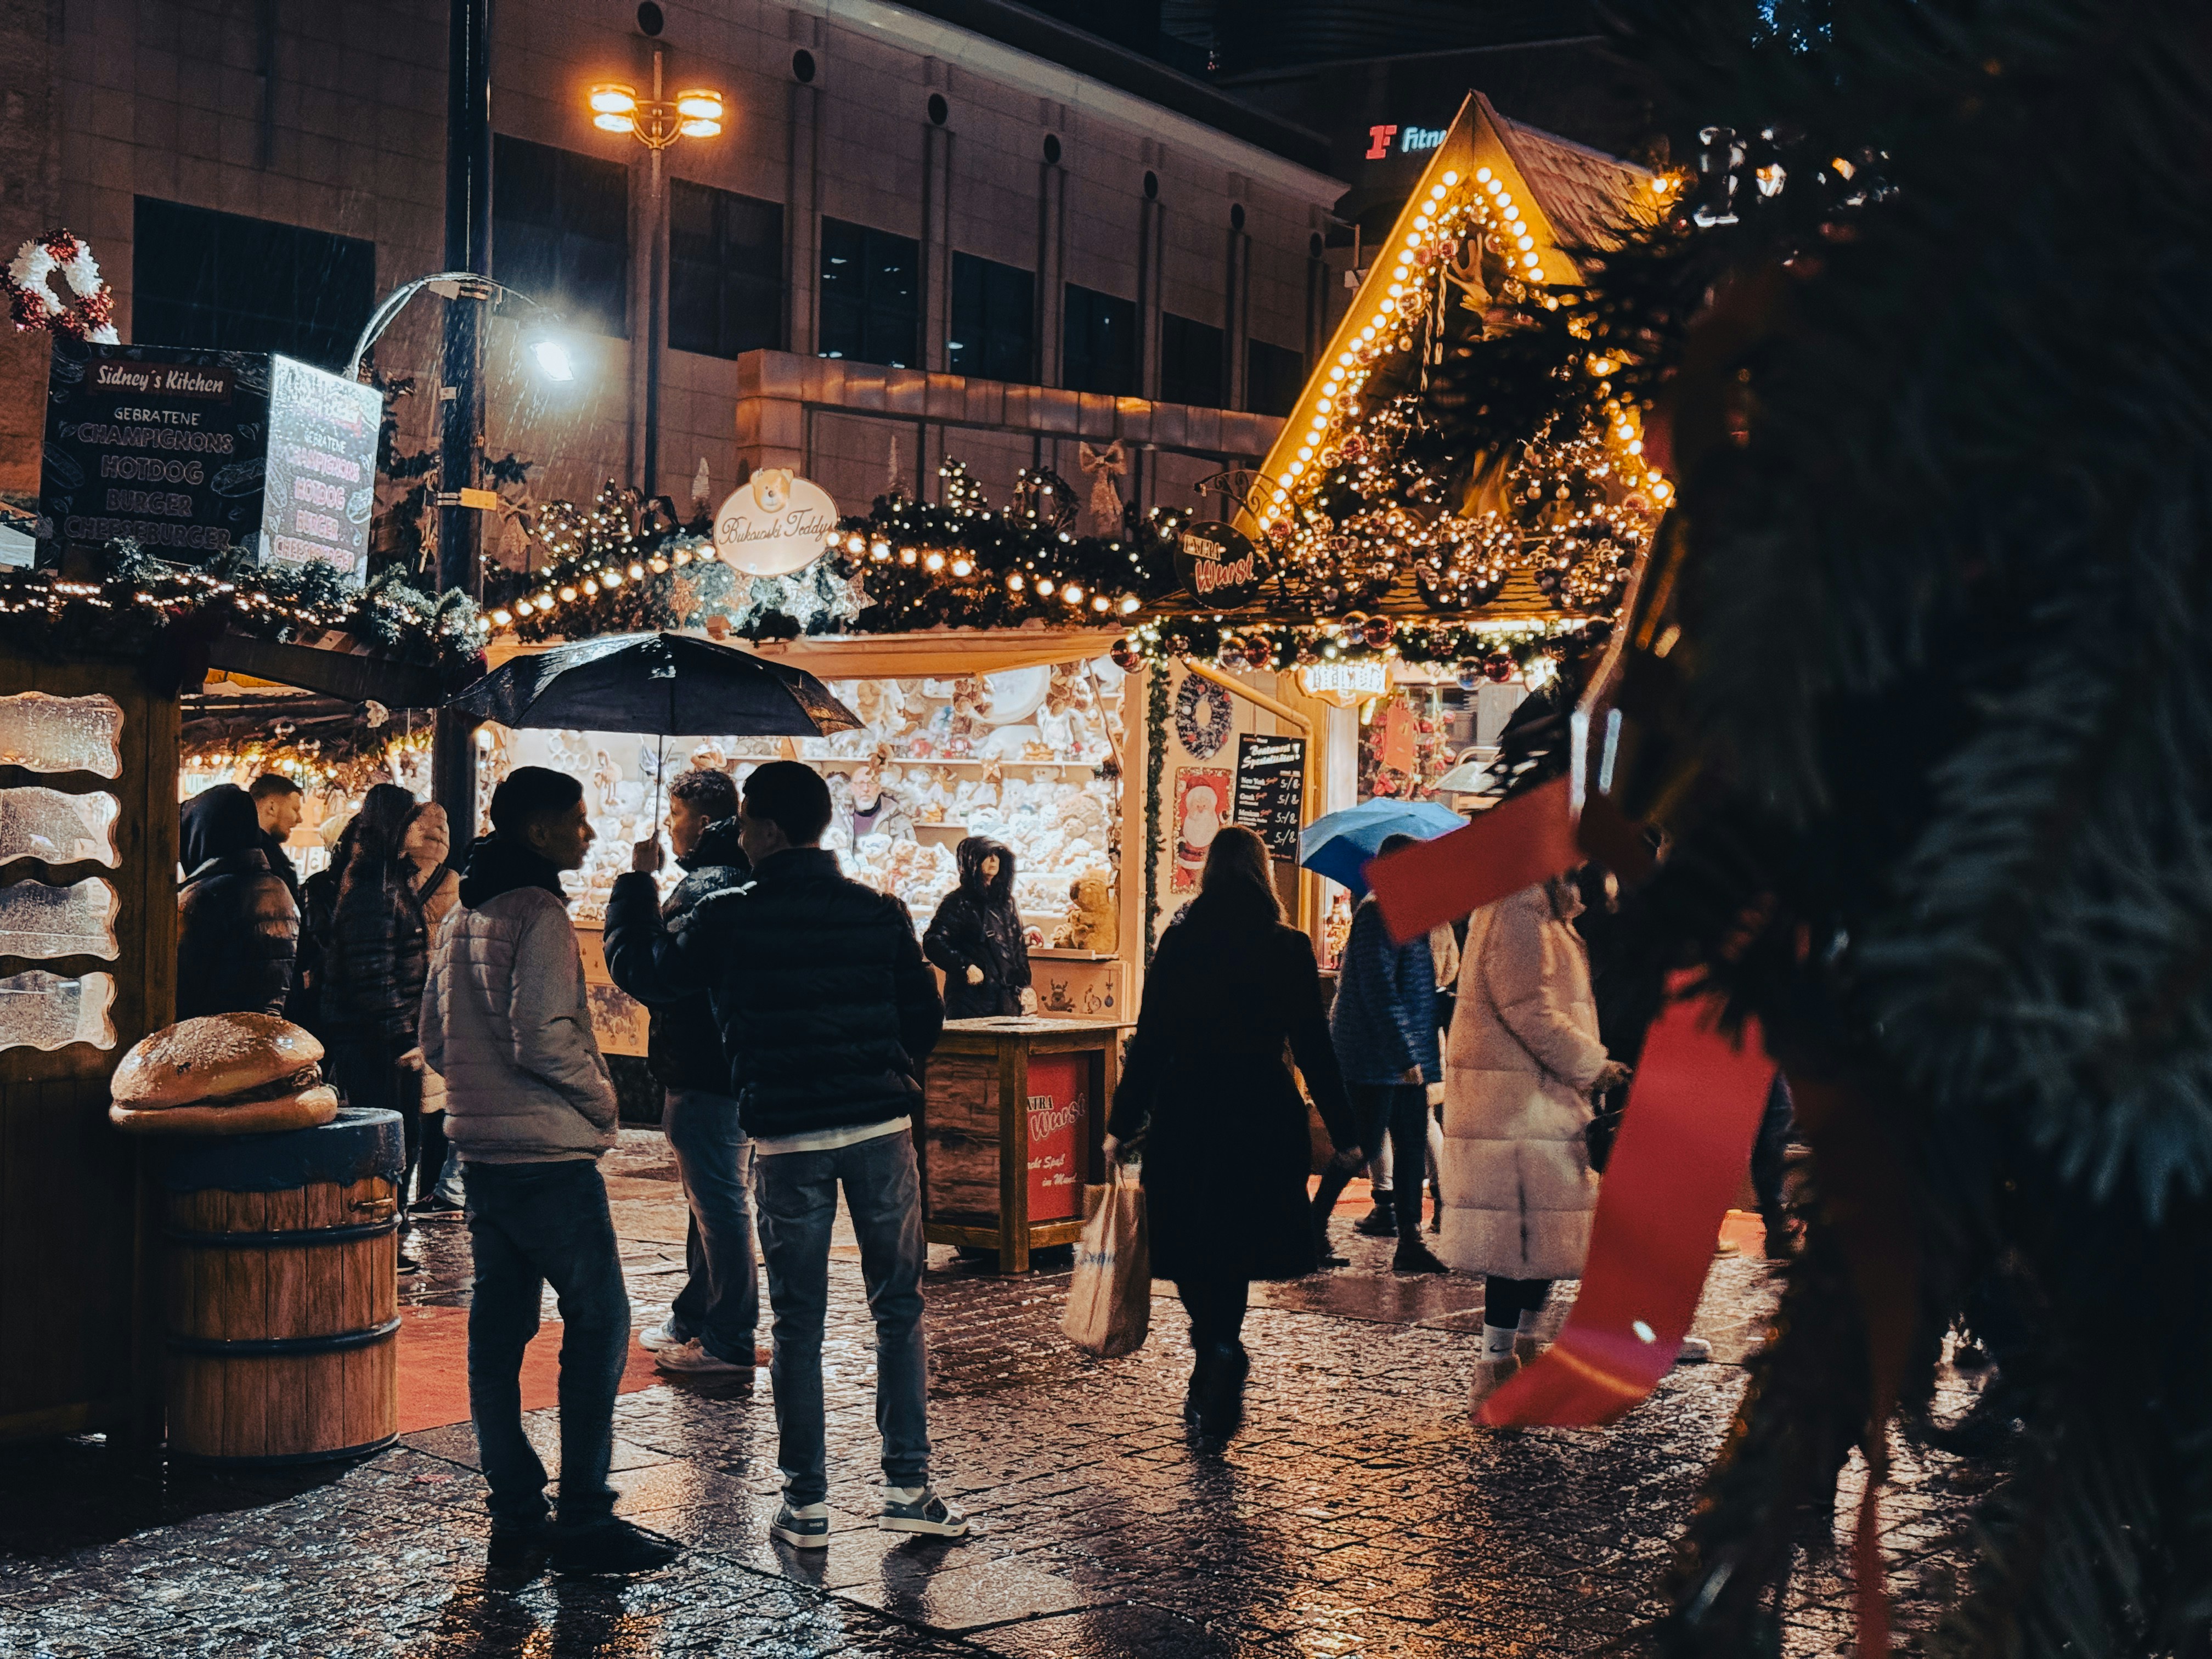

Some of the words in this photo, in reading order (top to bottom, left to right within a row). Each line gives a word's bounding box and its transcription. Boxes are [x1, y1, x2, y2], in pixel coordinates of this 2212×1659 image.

[166, 370, 223, 393] Kitchen
[114, 407, 201, 426] GEBRATENE
[78, 423, 234, 454] CHAMPIGNONS
[101, 455, 204, 485] HOTDOG
[106, 489, 192, 517] BURGER
[295, 476, 346, 511] HOTDOG
[64, 515, 231, 551] CHEESEBURGER
[296, 509, 338, 541] BURGER
[719, 517, 782, 545] Bukowski
[1195, 551, 1254, 594] Wurst
